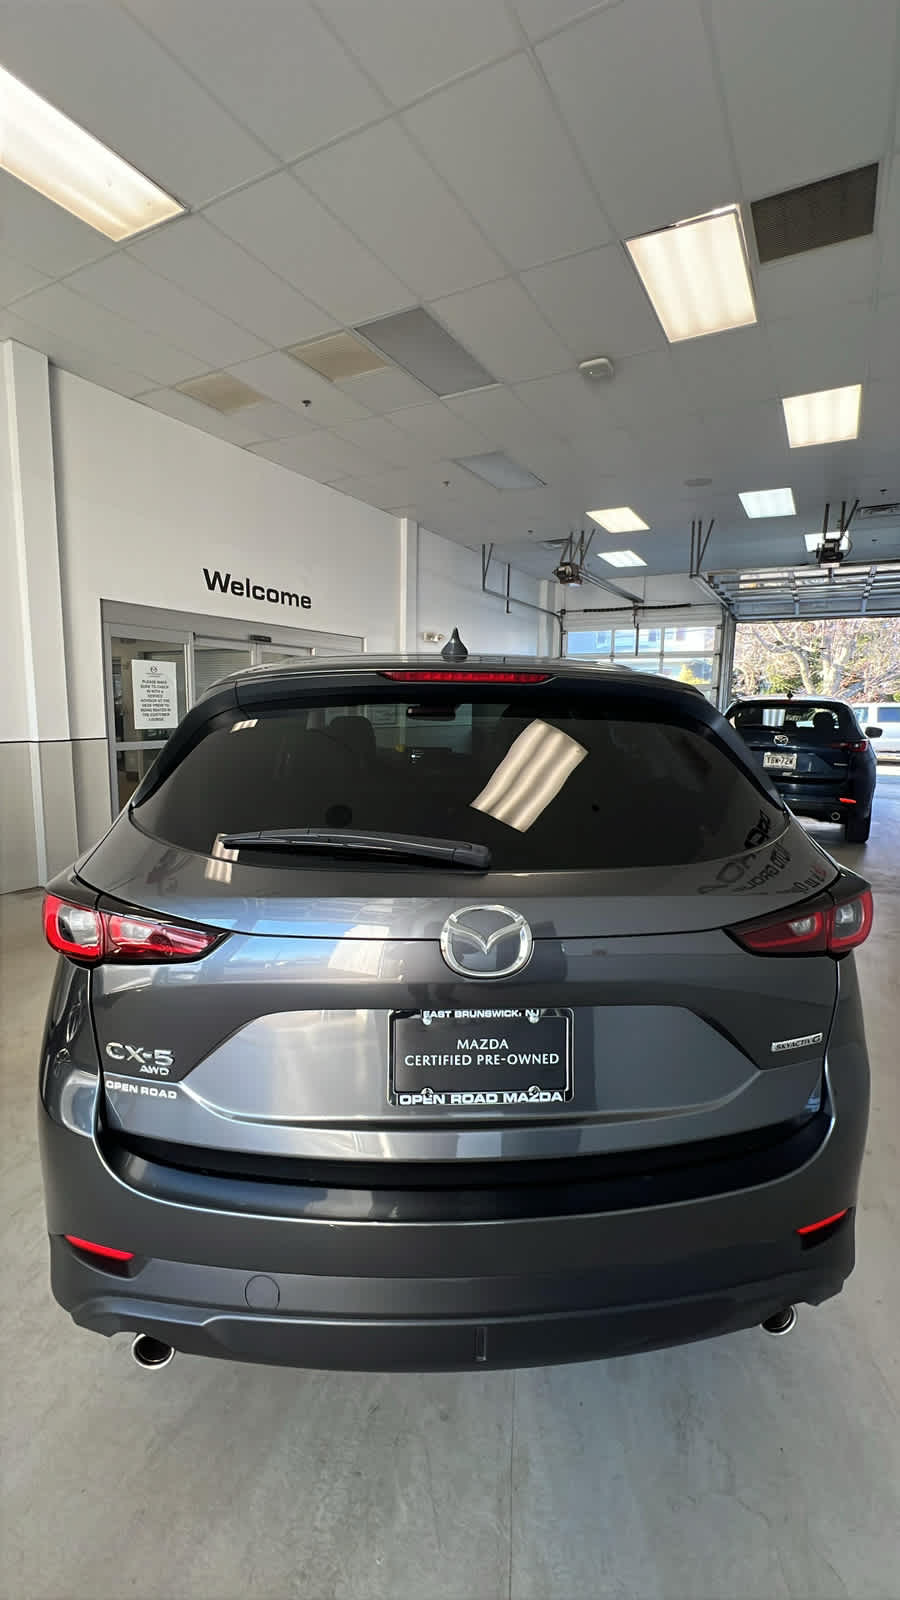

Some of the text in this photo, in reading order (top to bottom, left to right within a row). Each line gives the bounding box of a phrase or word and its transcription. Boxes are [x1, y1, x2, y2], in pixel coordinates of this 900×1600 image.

[202, 567, 312, 609] Welcome
[422, 1010, 452, 1019] EAST
[456, 1038, 509, 1050] MAZDA
[105, 1041, 174, 1066] CX-5
[404, 1053, 560, 1067] CERTIFIED PRE-OWNED
[139, 1064, 170, 1076] AWD
[105, 1080, 177, 1099] OPEN ROAD
[399, 1091, 563, 1105] OPEN ROAD MAZDA
